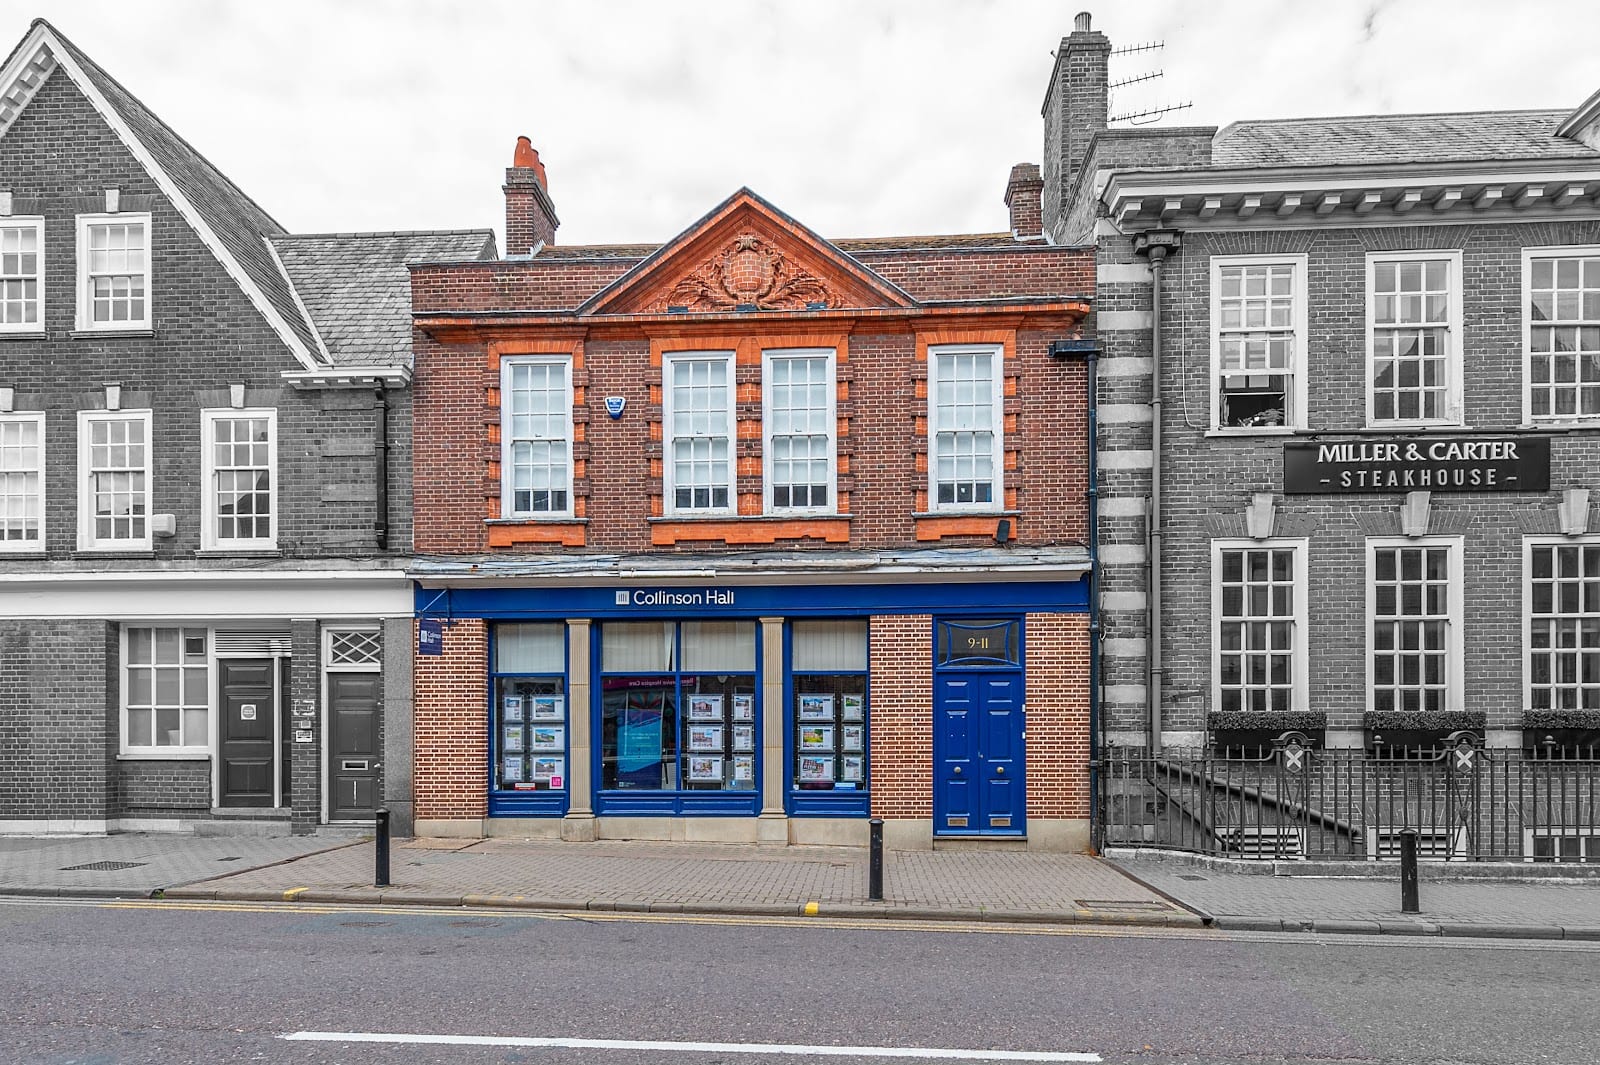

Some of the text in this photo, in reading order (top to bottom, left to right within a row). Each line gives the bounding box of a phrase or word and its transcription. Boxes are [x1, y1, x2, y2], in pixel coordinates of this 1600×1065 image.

[1317, 441, 1520, 463] MILLER & CARTER
[1340, 468, 1497, 487] STEAKHOUSE
[633, 589, 735, 605] Collinson Hall
[967, 637, 989, 649] 9-11
